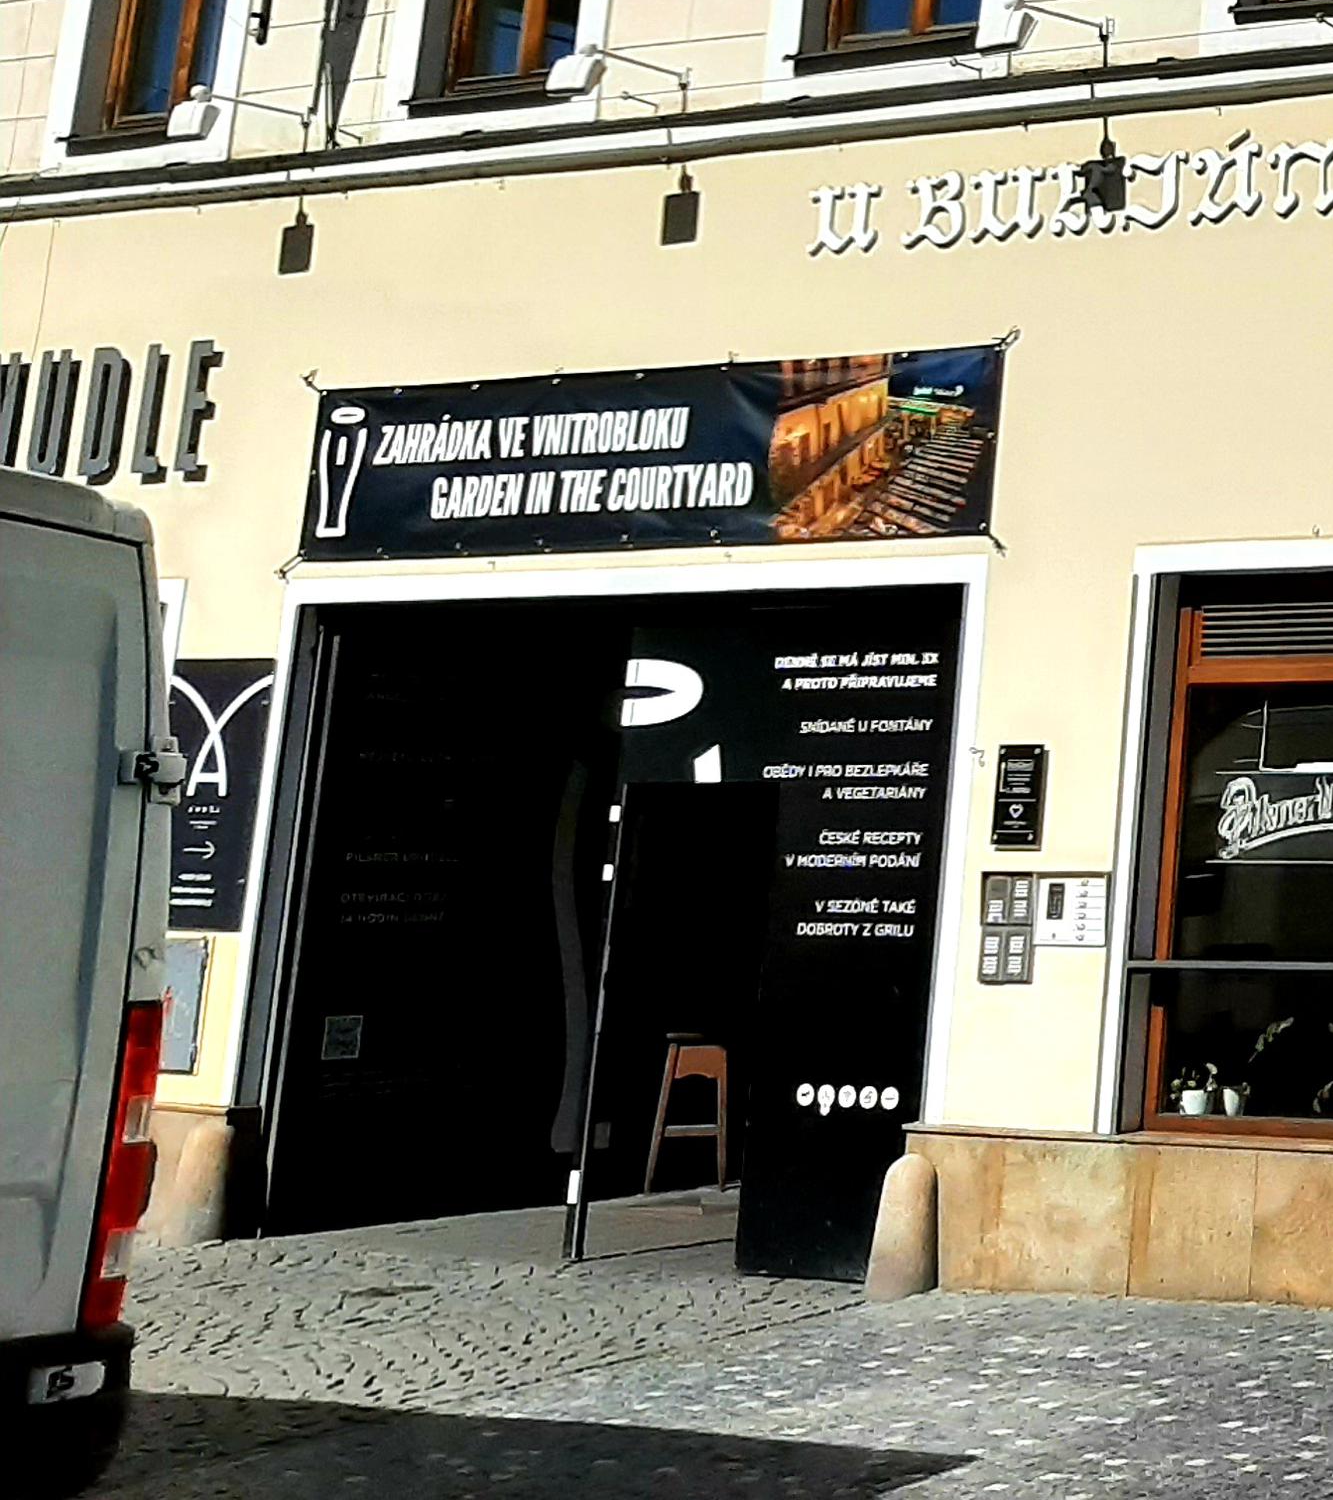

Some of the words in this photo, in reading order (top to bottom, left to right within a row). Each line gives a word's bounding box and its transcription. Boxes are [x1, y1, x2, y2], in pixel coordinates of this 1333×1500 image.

[372, 414, 492, 466] ZAHRÁDKA
[499, 416, 529, 459] VE
[532, 406, 690, 457] VNITROBLOKU
[429, 473, 520, 520] GARDEN
[524, 471, 556, 516] IN
[559, 468, 609, 514] THE
[607, 462, 754, 512] COURTYARD
[838, 652, 858, 667] MÁ
[861, 652, 888, 667] JÍST
[781, 678, 792, 691] A
[794, 677, 838, 690] PROTO
[858, 720, 868, 732] U
[869, 716, 933, 732] FONTÁNY
[763, 763, 806, 779] OBĚDY
[815, 765, 842, 778] PRO
[844, 761, 930, 777] BEZLEPKÁŘE
[822, 787, 833, 800] A
[836, 783, 928, 800] VEGETARIÁNY
[1217, 776, 1320, 860] Pilsner
[819, 829, 861, 845] ČESKÉ
[862, 831, 923, 845] RECEPTY
[785, 853, 795, 867] V
[869, 851, 922, 868] PODÁNÍ
[815, 900, 825, 913] V
[882, 898, 917, 914] TAKÉ
[796, 922, 860, 936] DOBROTY
[861, 922, 874, 937] Z
[874, 924, 916, 937] GRILU
